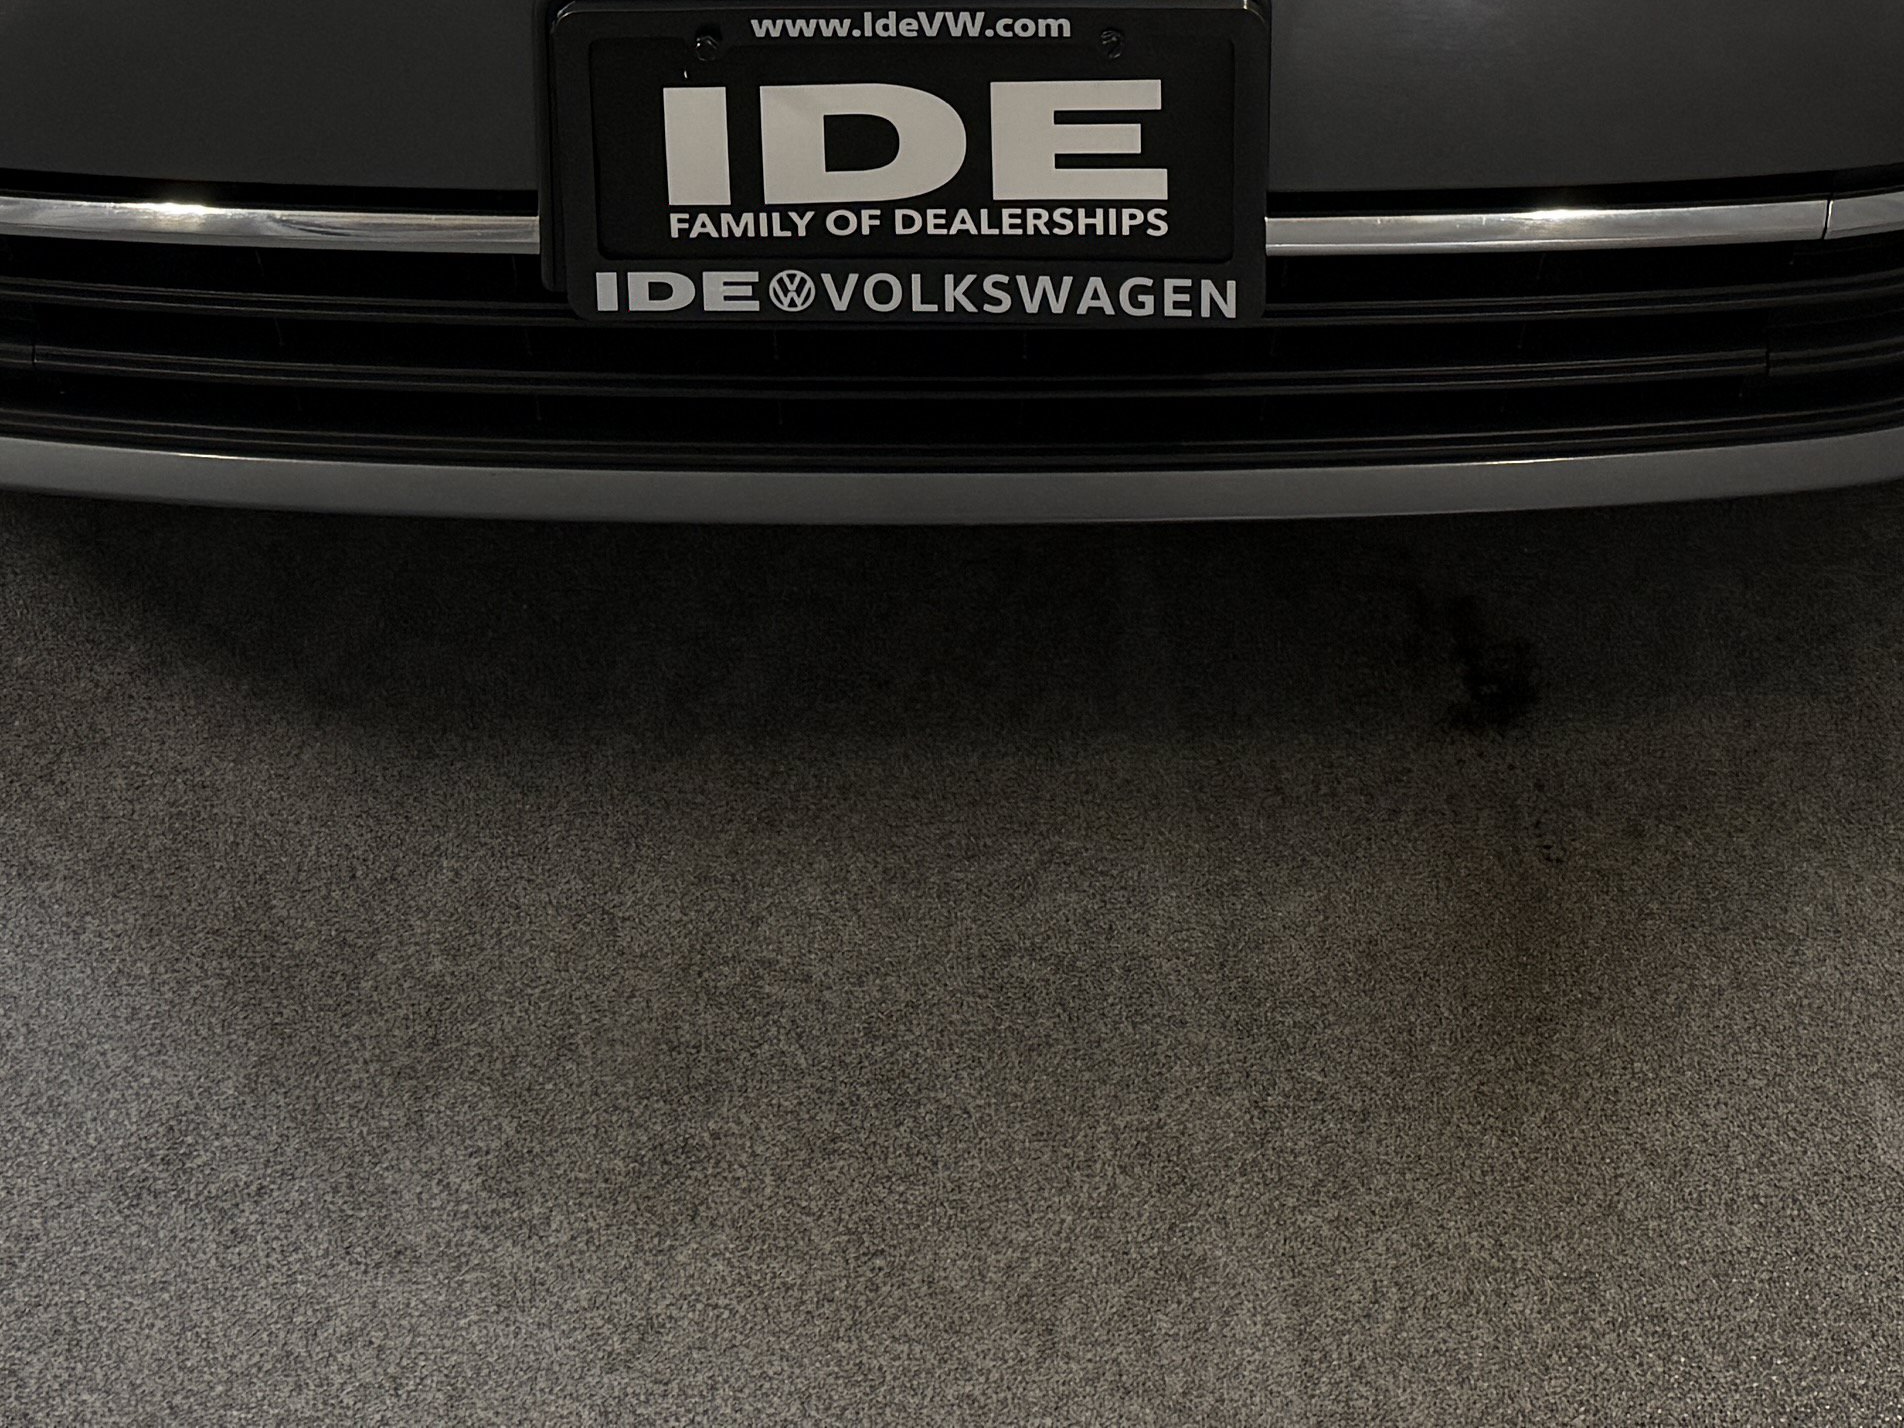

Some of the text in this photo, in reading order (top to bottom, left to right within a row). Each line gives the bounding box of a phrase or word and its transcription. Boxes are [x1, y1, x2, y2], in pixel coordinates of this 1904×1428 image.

[750, 10, 1072, 39] www.IdeVW.com
[662, 79, 1169, 206] IDE
[669, 207, 1169, 239] FAMILY OF DEALERSHIPS
[595, 271, 760, 312] IDE
[820, 272, 1237, 319] VOLKSWAGEN
